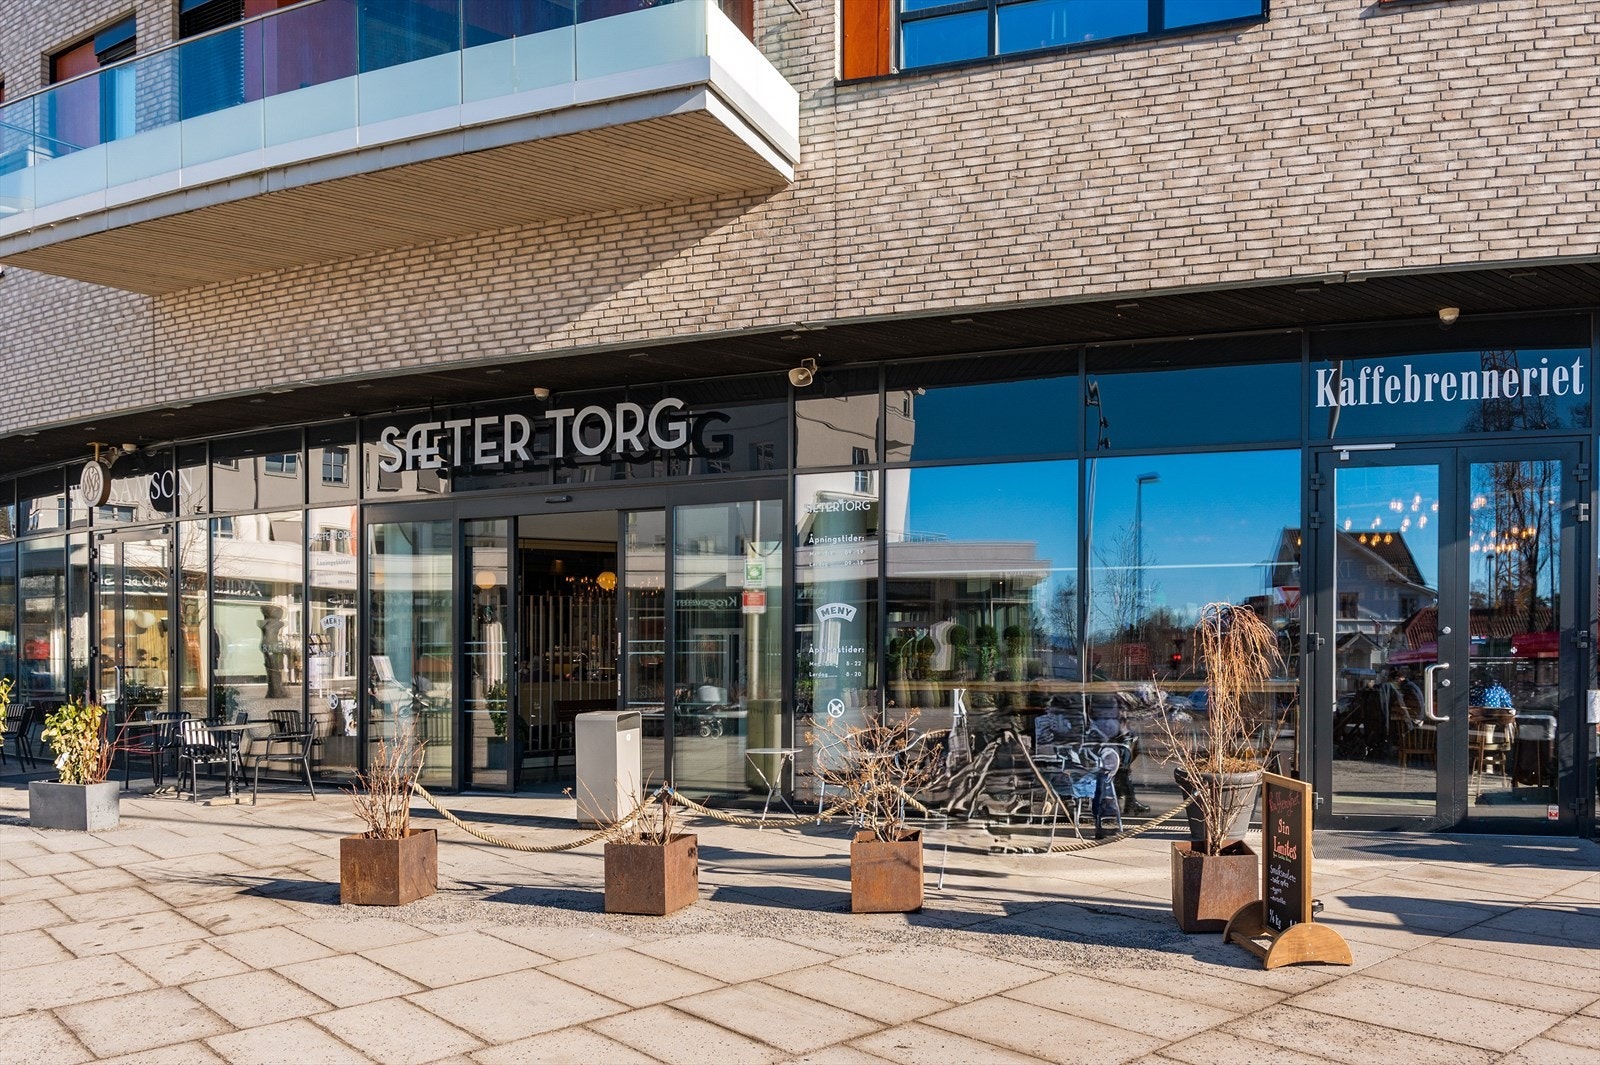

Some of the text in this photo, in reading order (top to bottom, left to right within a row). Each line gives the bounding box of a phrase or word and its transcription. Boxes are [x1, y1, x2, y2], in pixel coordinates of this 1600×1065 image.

[1315, 356, 1584, 408] Kaffebrenneriet
[379, 397, 688, 473] SÆTER TORG
[808, 533, 865, 545] Åpningstider:
[820, 606, 852, 617] MENY
[808, 643, 865, 655] Åpnigstider:
[1278, 818, 1290, 835] Sin
[1275, 914, 1282, 930] kg
